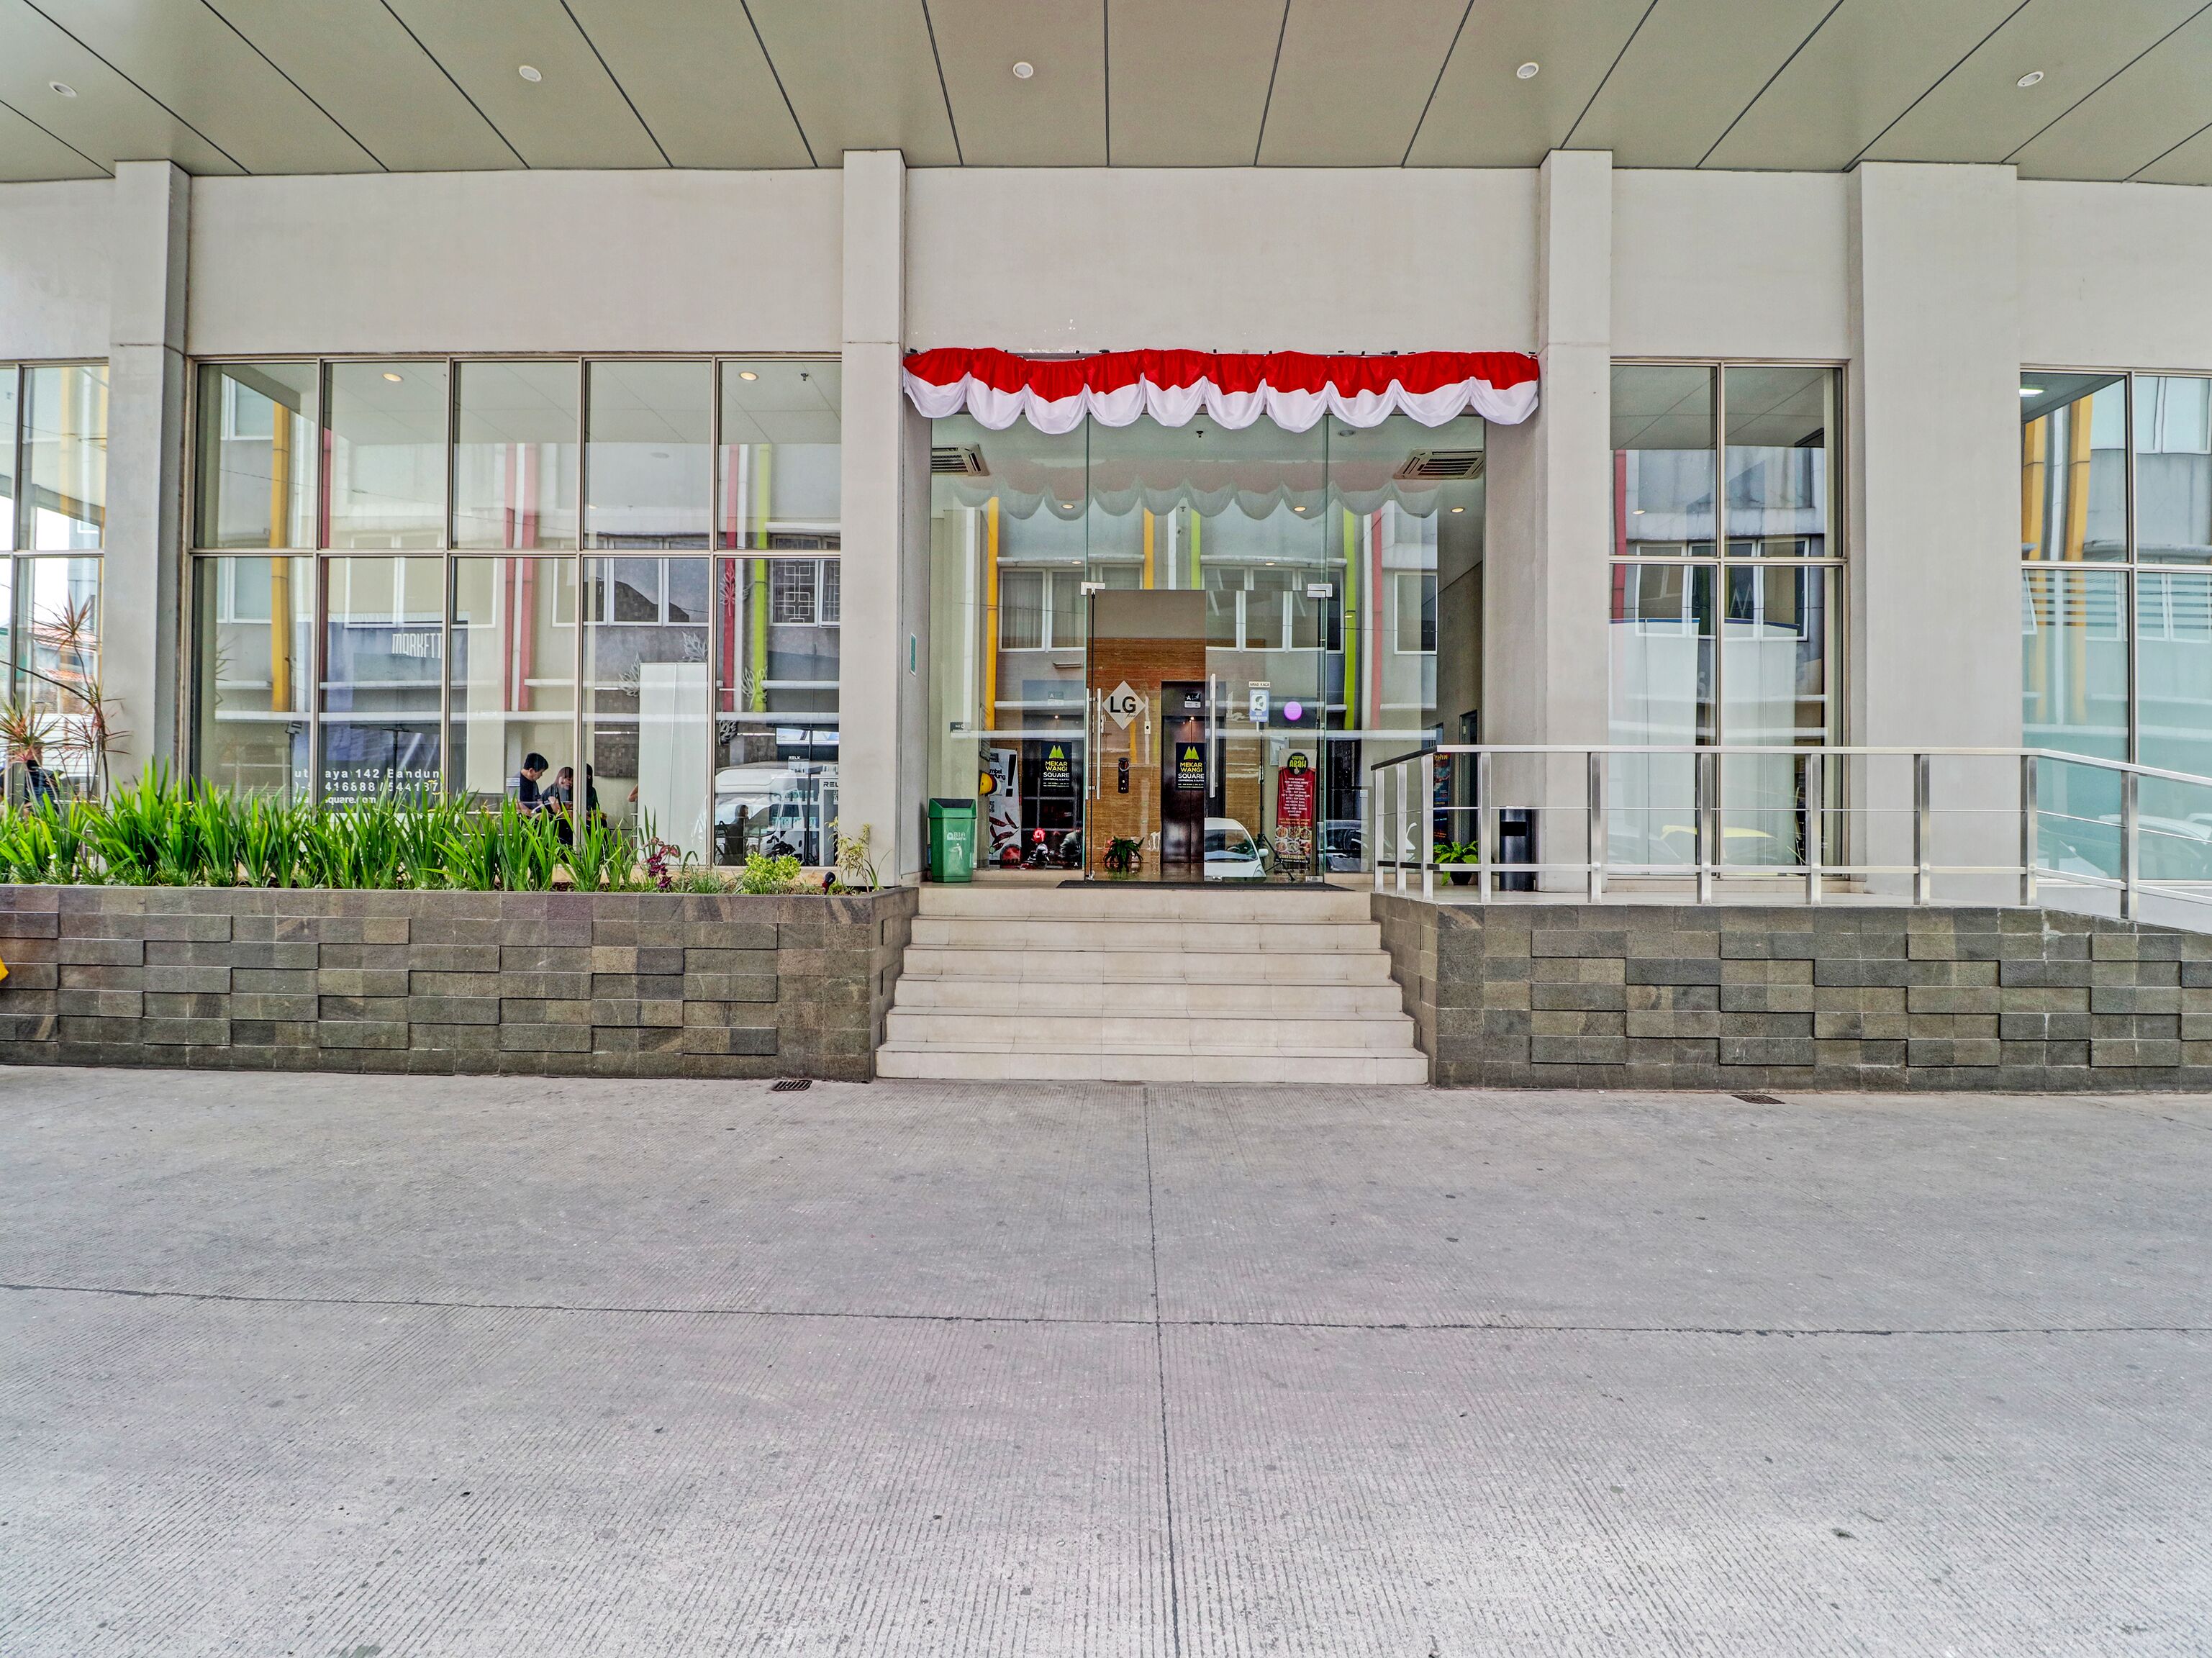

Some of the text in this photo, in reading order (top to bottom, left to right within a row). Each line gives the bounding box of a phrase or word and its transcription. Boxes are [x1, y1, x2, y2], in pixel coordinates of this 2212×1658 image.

[1110, 696, 1136, 713] LG
[355, 769, 380, 779] 142
[387, 769, 440, 779] Bandun
